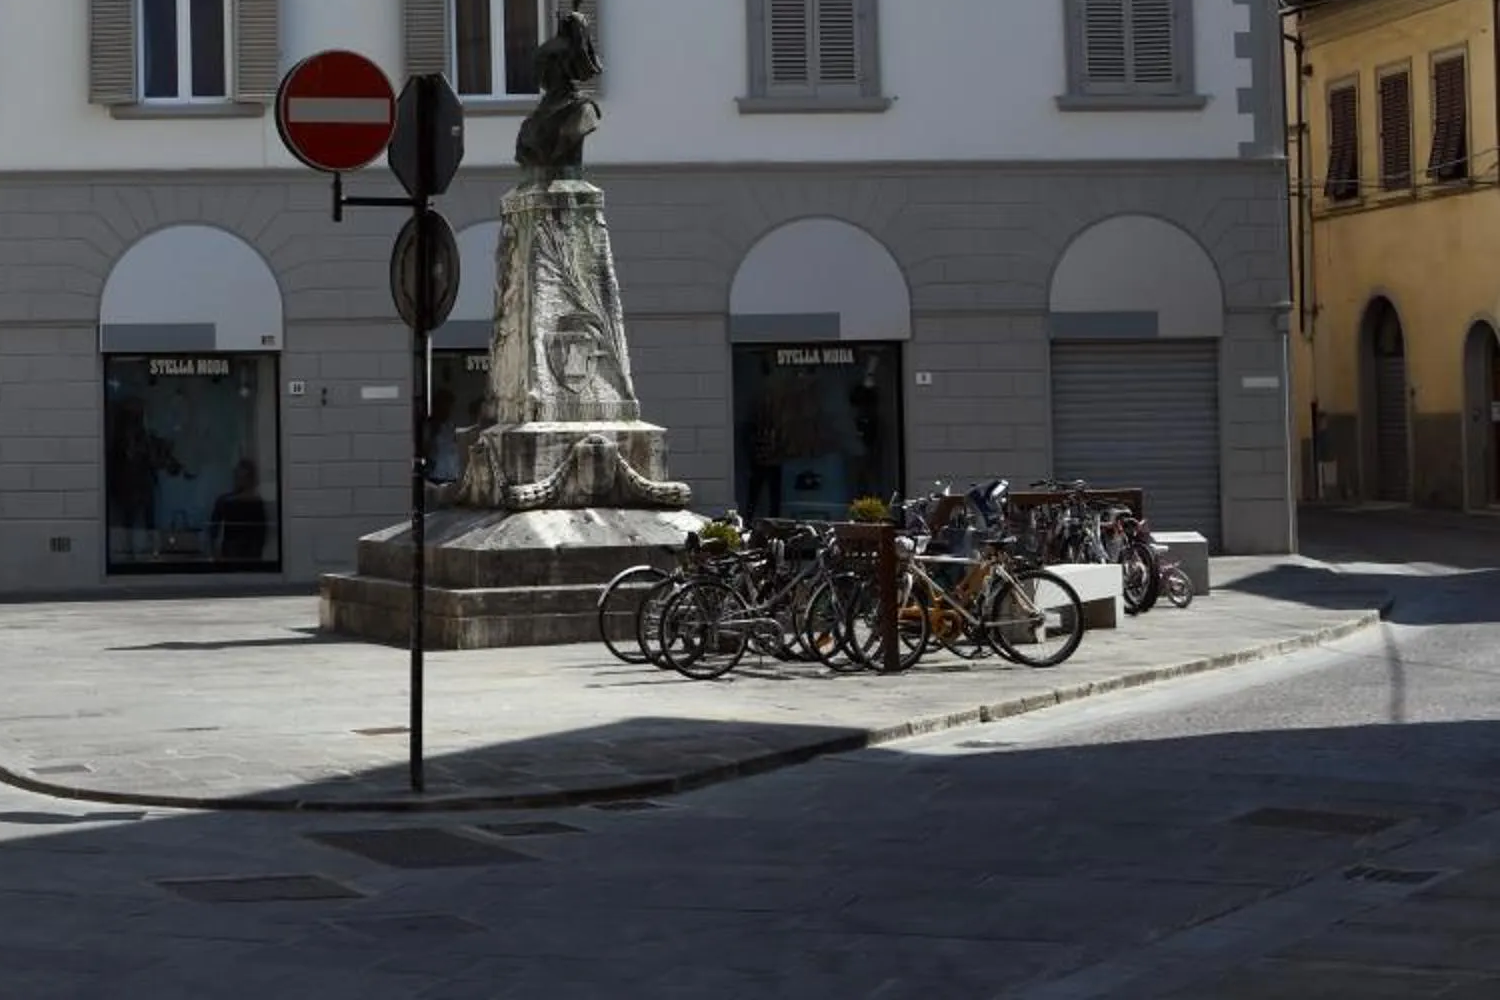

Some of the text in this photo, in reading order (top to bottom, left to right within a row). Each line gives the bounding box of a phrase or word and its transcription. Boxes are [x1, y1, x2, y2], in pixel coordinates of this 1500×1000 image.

[777, 349, 821, 365] STELLA
[149, 359, 229, 375] STELLA MODA
